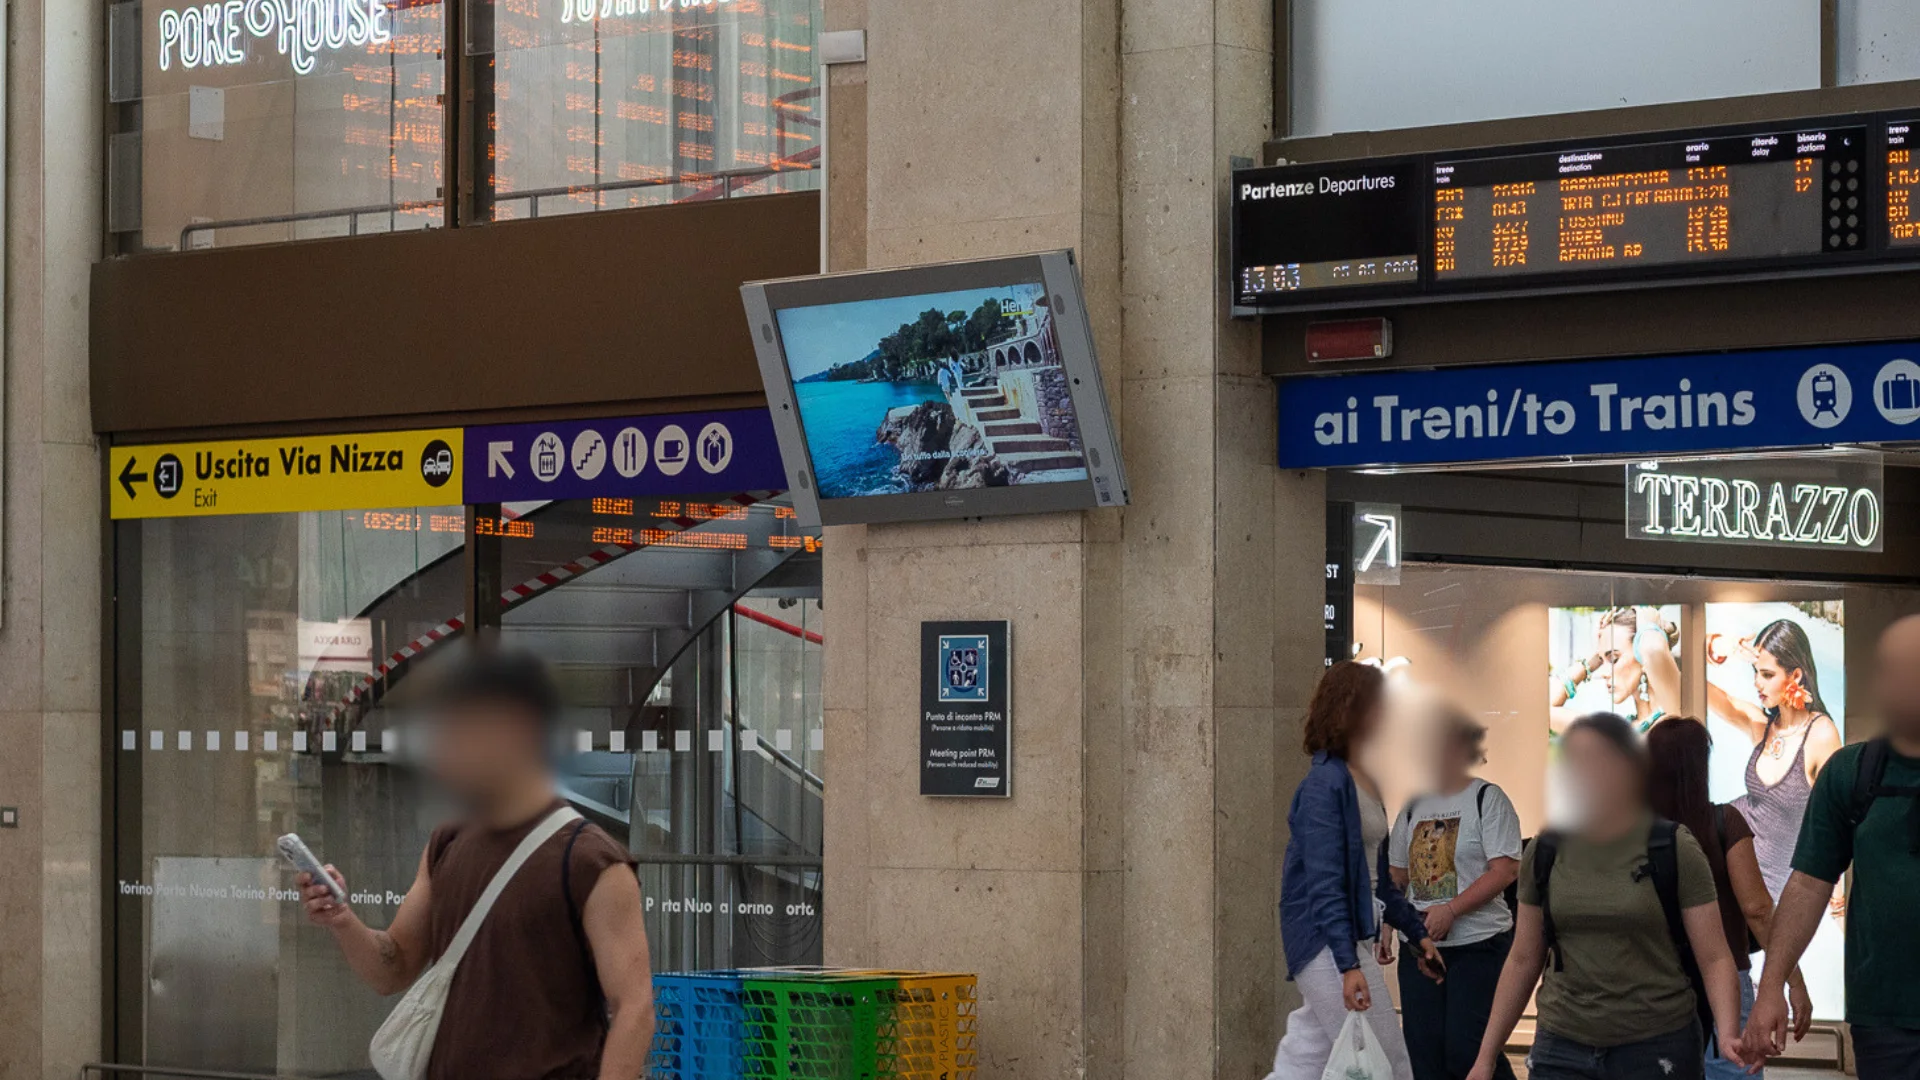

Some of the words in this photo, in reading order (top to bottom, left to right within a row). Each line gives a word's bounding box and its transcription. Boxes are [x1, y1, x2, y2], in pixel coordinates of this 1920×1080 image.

[159, 3, 245, 71] POKE
[245, 0, 391, 75] HOUSE
[1889, 124, 1909, 135] treno
[1751, 135, 1779, 148] ritardo
[1797, 132, 1826, 143] binario
[1889, 135, 1904, 145] train
[1686, 142, 1709, 152] orario
[1752, 147, 1770, 158] delay
[1797, 142, 1825, 154] platform
[1558, 152, 1602, 164] destinazione
[1686, 152, 1700, 163] time
[1436, 166, 1454, 175] treno
[1558, 162, 1592, 174] destination
[1241, 181, 1315, 200] Partenze
[1319, 175, 1396, 196] Departures
[1313, 396, 1359, 446] ai
[1373, 388, 1576, 441] Treni/to
[1590, 378, 1756, 432] Trains
[933, 449, 951, 459] dalla
[194, 449, 270, 481] Uscita
[278, 445, 321, 476] Via
[330, 443, 404, 473] Nizza
[194, 488, 217, 508] Exit
[1636, 473, 1880, 547] TERRAZZO
[925, 711, 946, 721] Punto
[946, 711, 954, 721] di
[955, 711, 983, 721] incontro
[984, 711, 1001, 721] PRM
[929, 748, 958, 759] Meeting
[959, 748, 977, 759] point
[978, 748, 995, 757] PRM
[958, 760, 977, 768] reduced
[119, 880, 153, 896] Torino
[153, 881, 186, 897] Porta
[189, 884, 228, 899] Nuova
[230, 885, 266, 900] Torino
[268, 886, 300, 901] Porta
[350, 889, 382, 904] orino
[385, 890, 406, 905] Por
[645, 897, 681, 913] Prta
[684, 898, 728, 914] Nuoa
[738, 901, 774, 916] orino
[786, 902, 815, 917] orta
